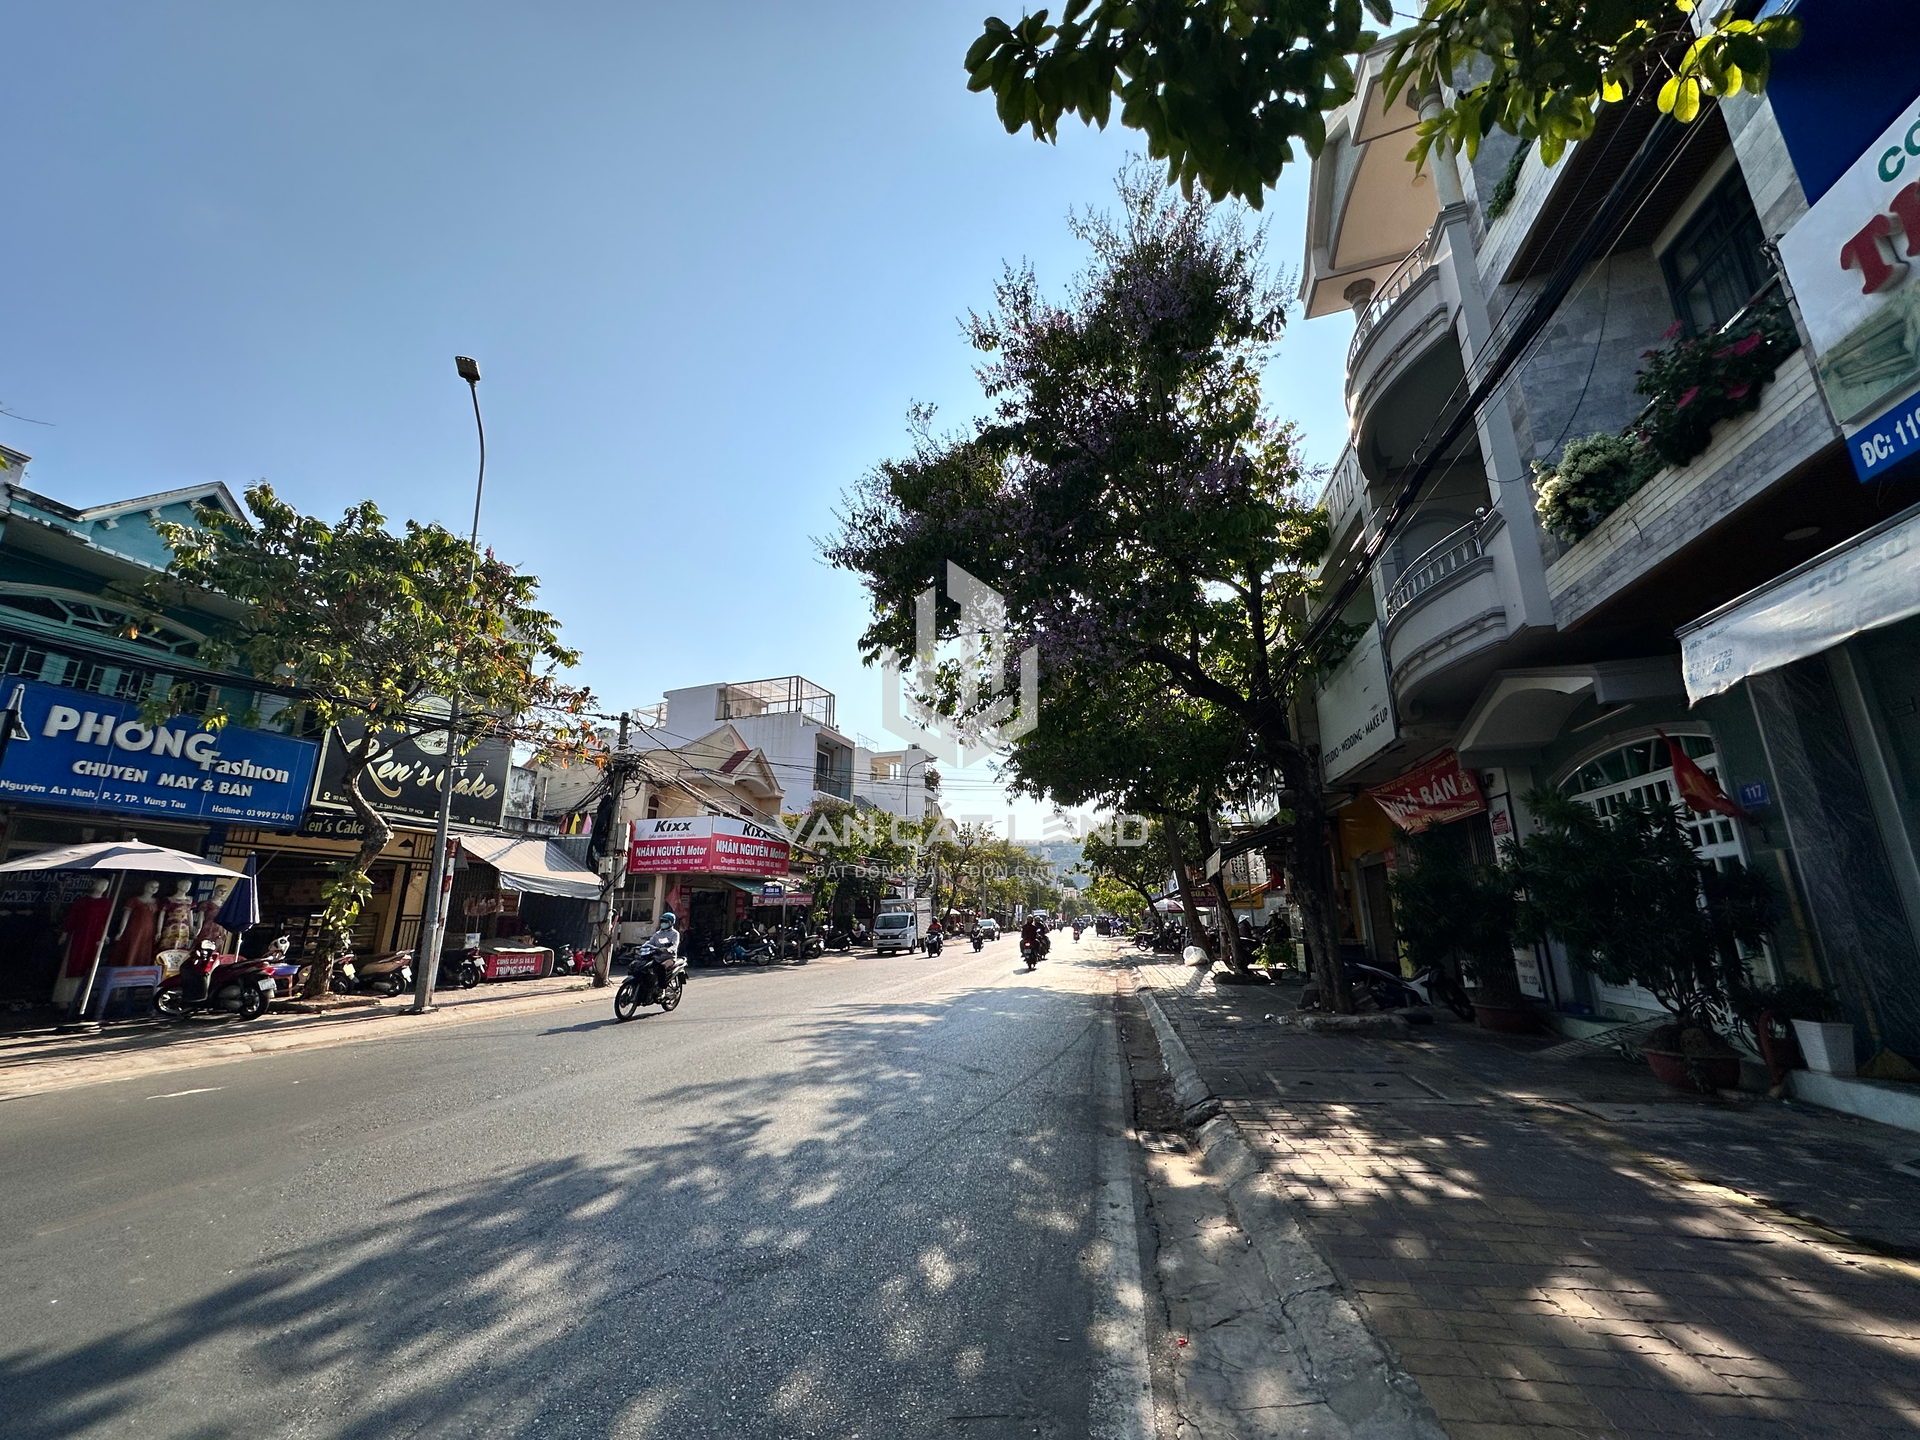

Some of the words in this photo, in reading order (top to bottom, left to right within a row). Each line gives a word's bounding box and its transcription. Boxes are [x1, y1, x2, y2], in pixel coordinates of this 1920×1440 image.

[1860, 432, 1894, 468] ĐC:
[42, 704, 217, 764] PHONG
[1325, 753, 1339, 766] STUDIO
[1341, 728, 1363, 752] WEDDING
[1365, 714, 1380, 736] MAKE
[1380, 707, 1388, 723] UP
[199, 748, 290, 784] Fashion
[157, 773, 199, 790] MAY
[201, 779, 214, 792] &
[218, 780, 253, 797] BÁN
[1745, 784, 1762, 799] 117
[50, 785, 67, 795] An
[102, 791, 111, 800] P.
[114, 793, 122, 803] 7,
[125, 794, 140, 803] TP.
[1388, 787, 1420, 818] NHÀ
[1419, 774, 1459, 806] BÁN
[212, 804, 244, 816] Hotline:
[335, 819, 366, 834] Cake
[653, 820, 692, 832] Kixx
[742, 823, 769, 839] Kixx
[636, 844, 656, 857] NHÂN
[687, 845, 708, 856] Motor
[716, 839, 738, 854] NHÂN
[769, 847, 787, 860] Motor
[60, 876, 94, 892] Fashio
[198, 880, 214, 891] NAM
[1, 890, 41, 903] MAY
[43, 891, 57, 902] &
